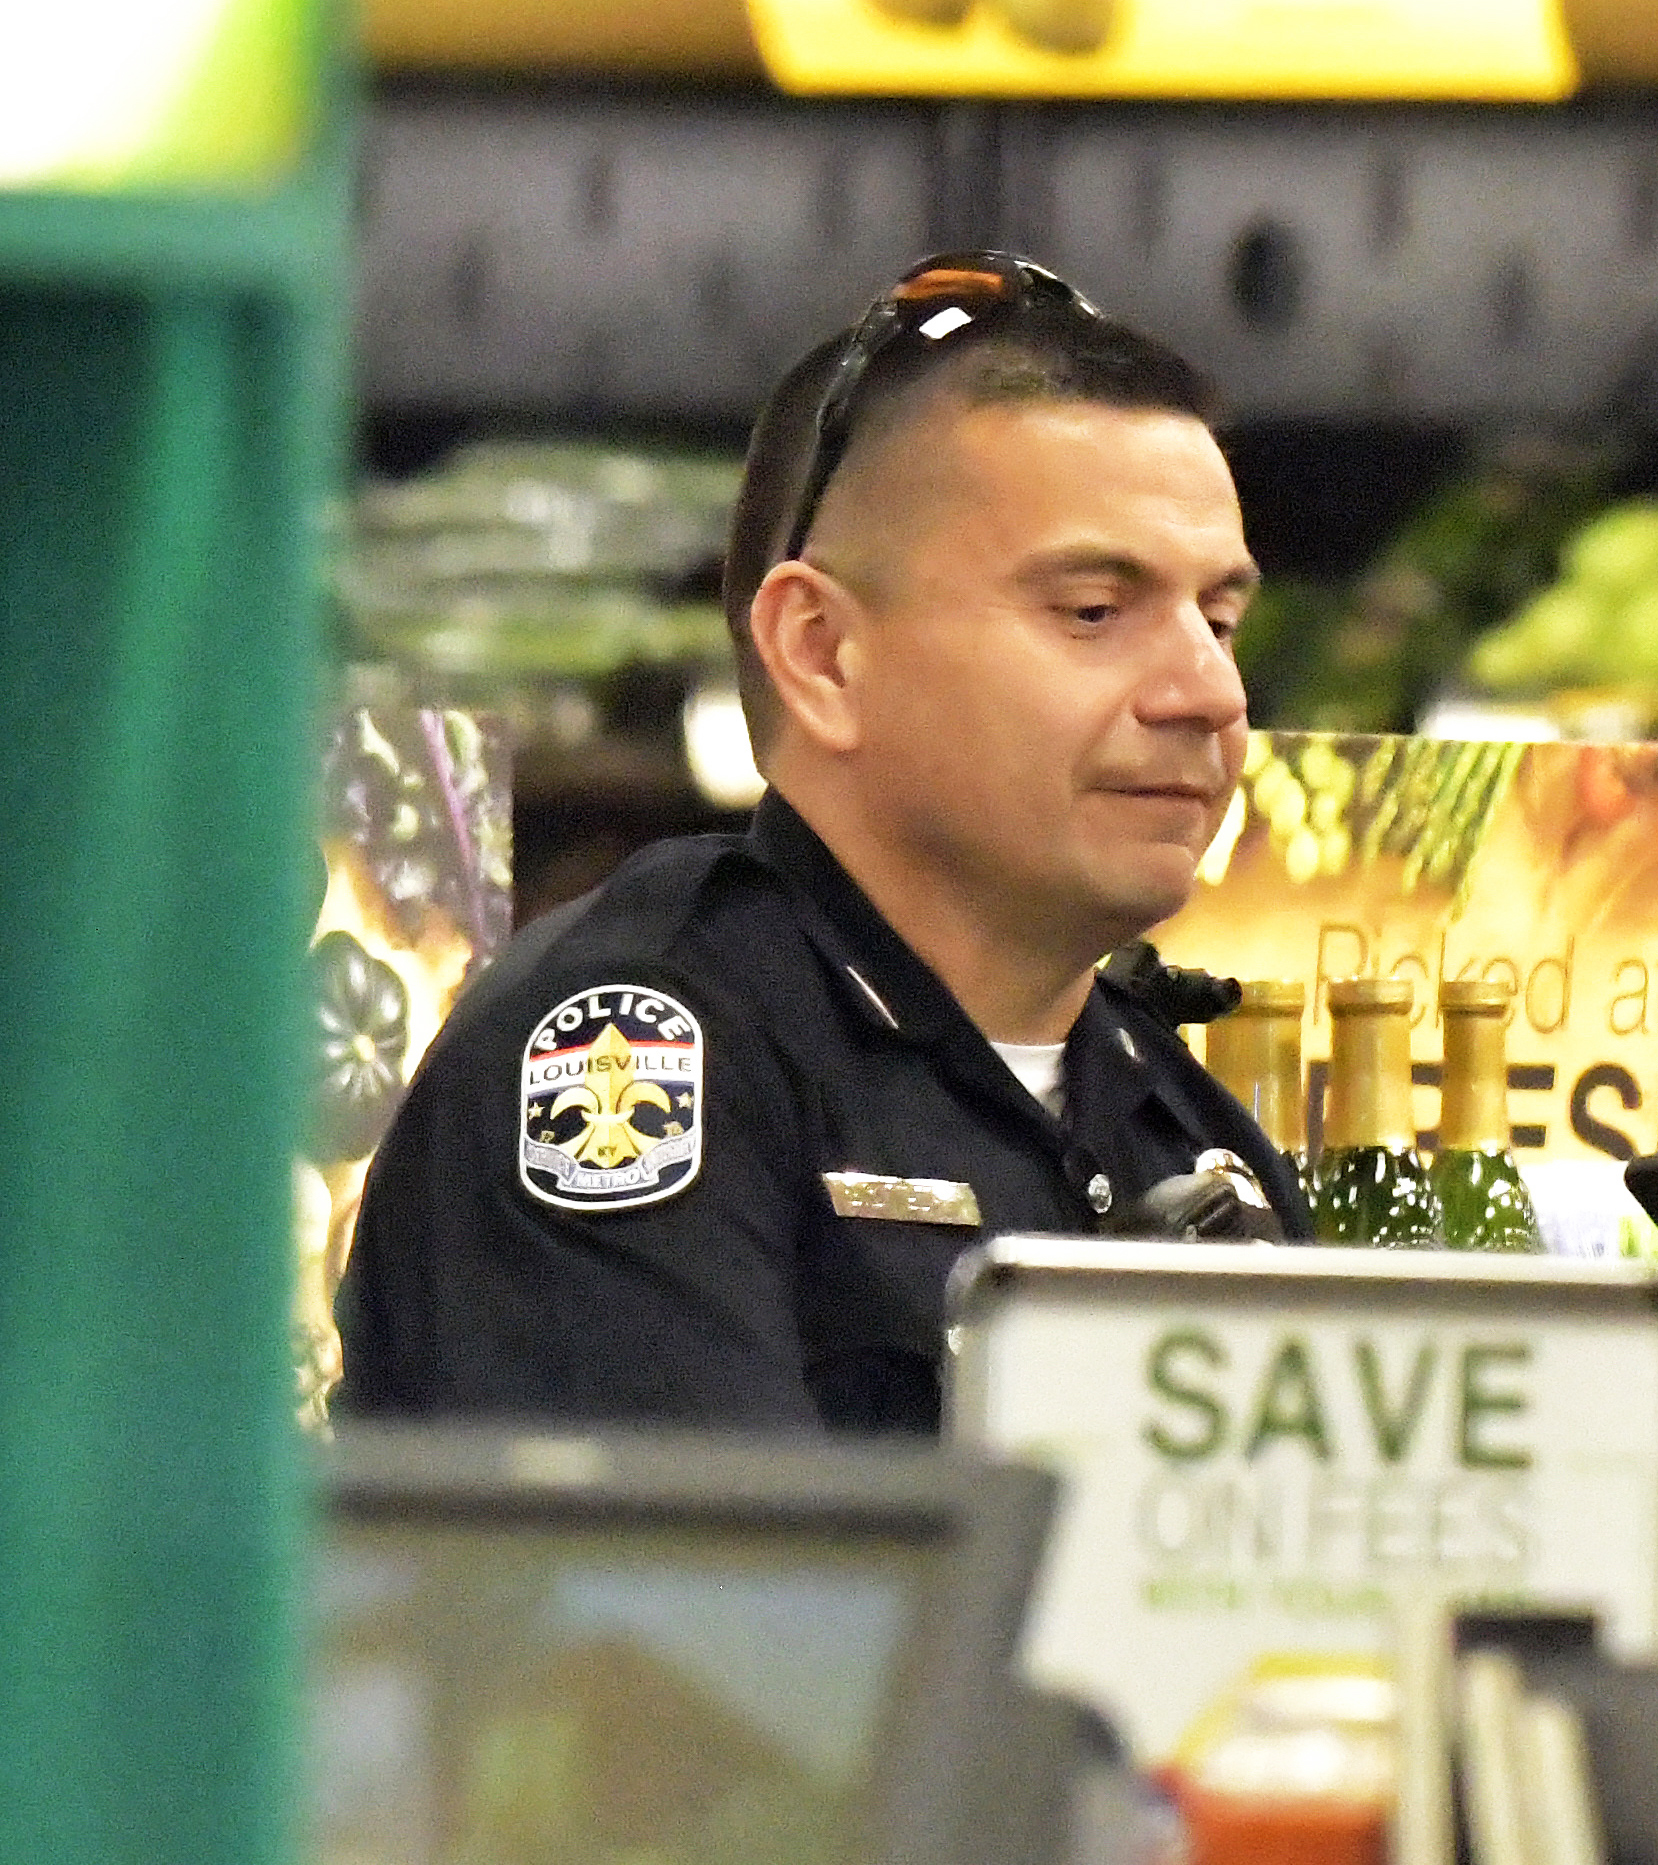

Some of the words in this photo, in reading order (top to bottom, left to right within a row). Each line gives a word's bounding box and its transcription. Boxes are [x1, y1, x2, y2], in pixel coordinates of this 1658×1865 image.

[534, 993, 692, 1051] POLICE
[529, 1054, 692, 1086] LOUISVILLE
[576, 1168, 641, 1188] METRO
[1139, 1328, 1535, 1470] SAVE
